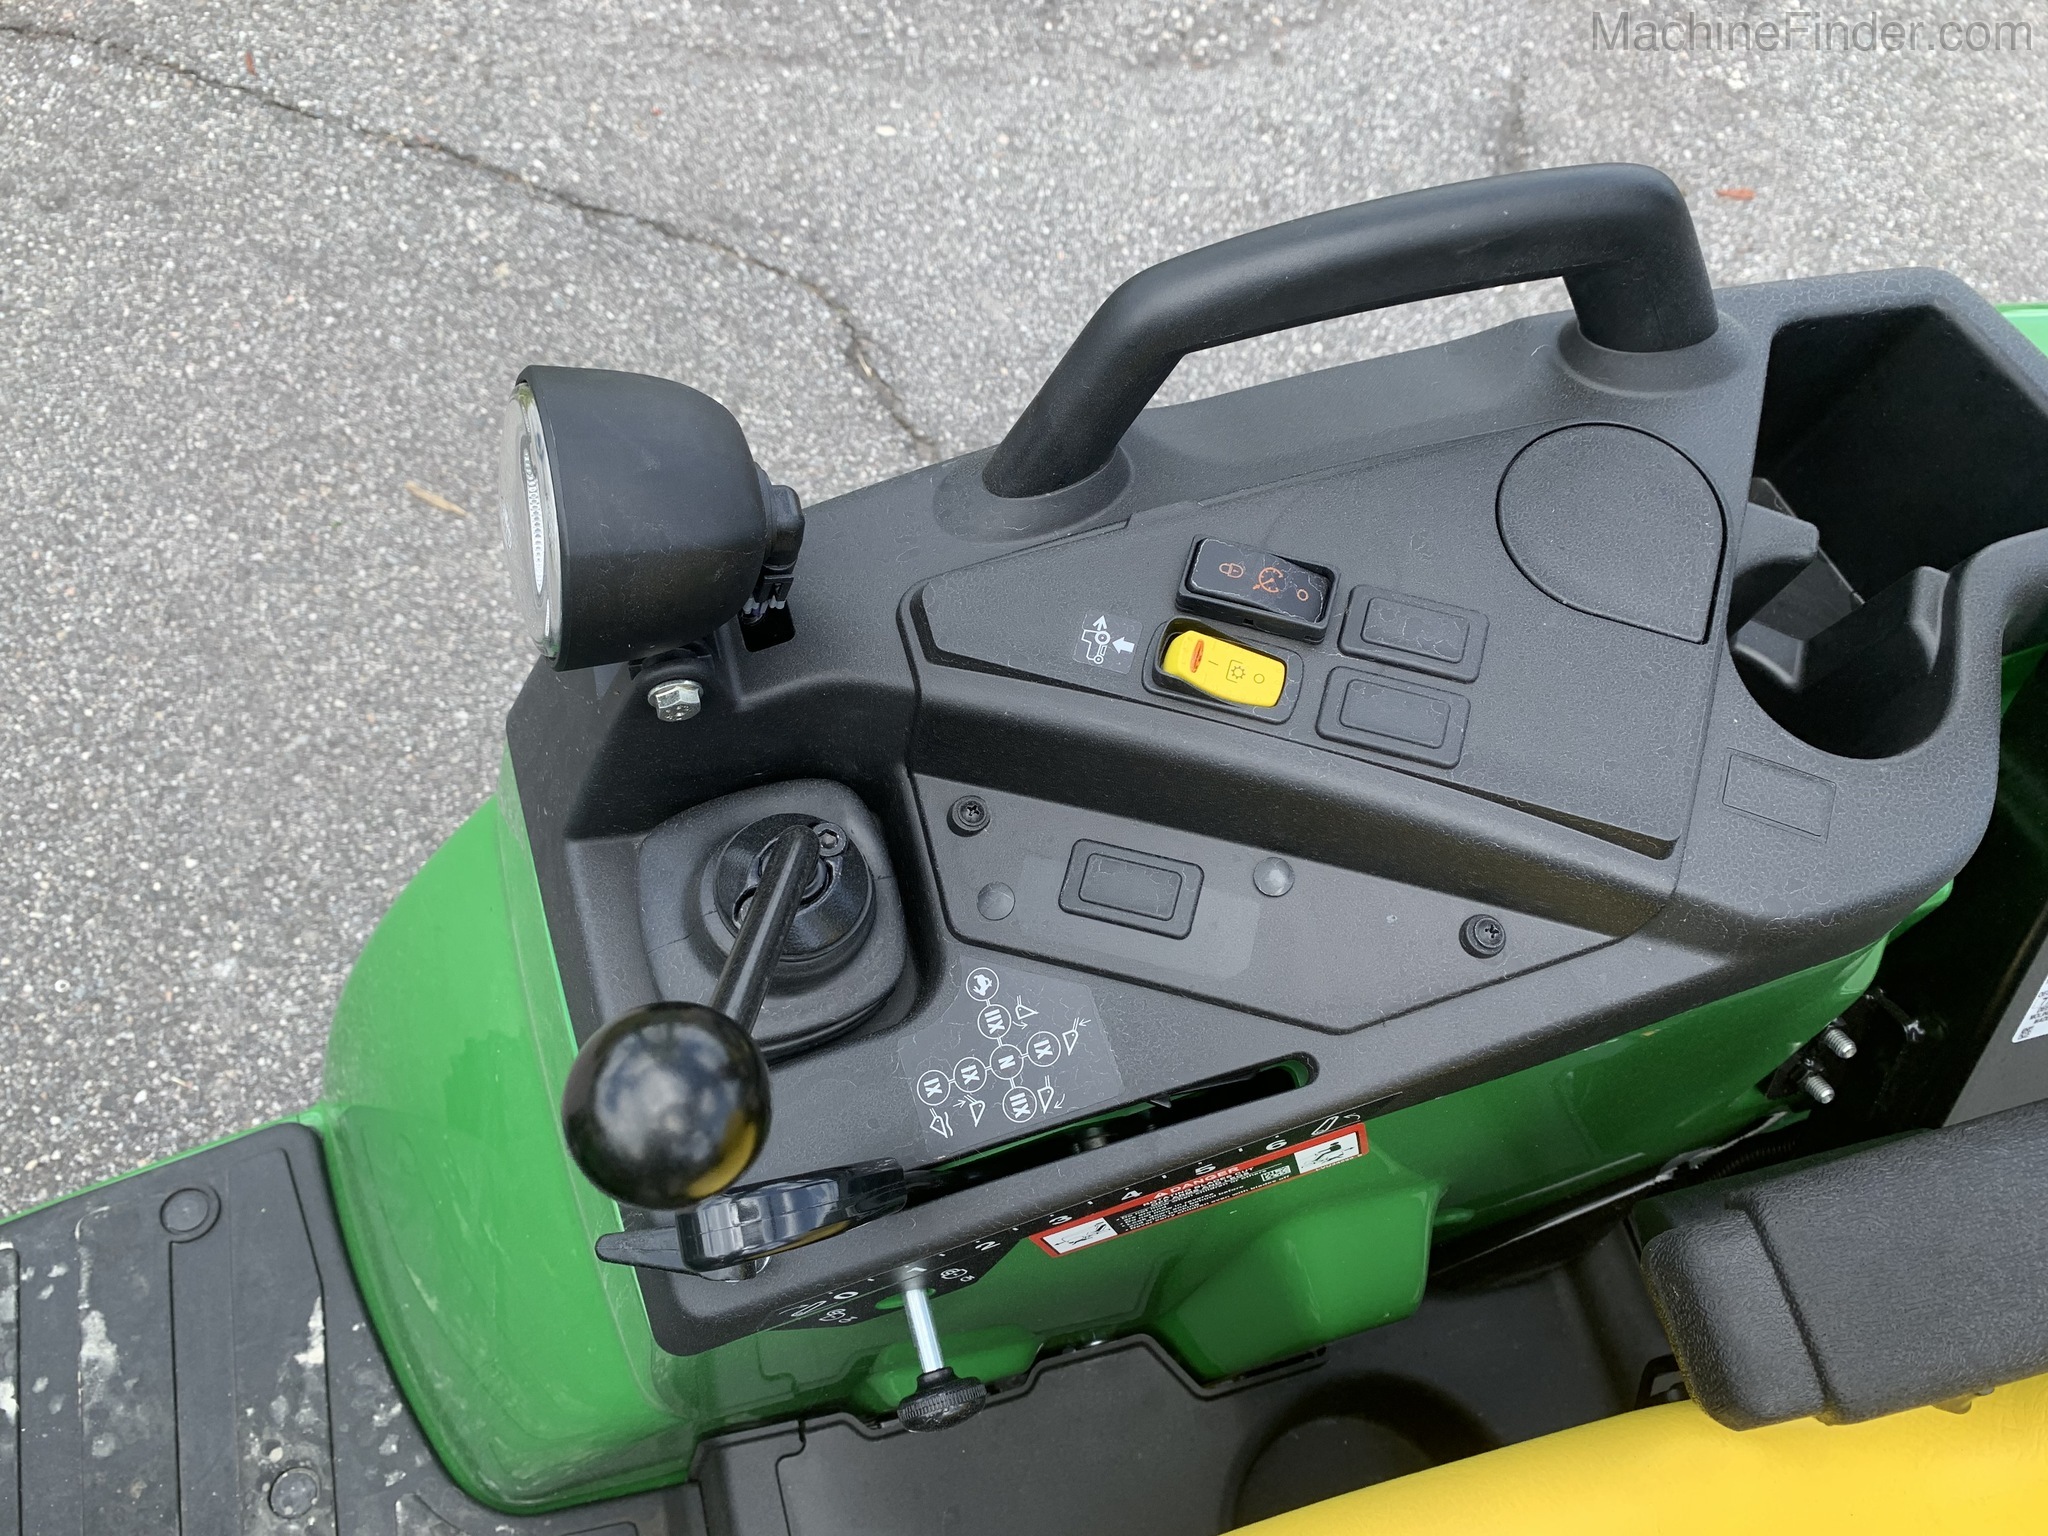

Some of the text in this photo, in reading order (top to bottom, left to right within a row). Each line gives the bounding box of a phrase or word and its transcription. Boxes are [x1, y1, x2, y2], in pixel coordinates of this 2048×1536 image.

[998, 1055, 1016, 1070] N
[1266, 1140, 1288, 1151] 6
[1195, 1164, 1217, 1176] 5
[1170, 1165, 1240, 1193] DANGER
[1121, 1190, 1142, 1200] 4
[1048, 1214, 1073, 1226] 3
[975, 1240, 1001, 1251] 2
